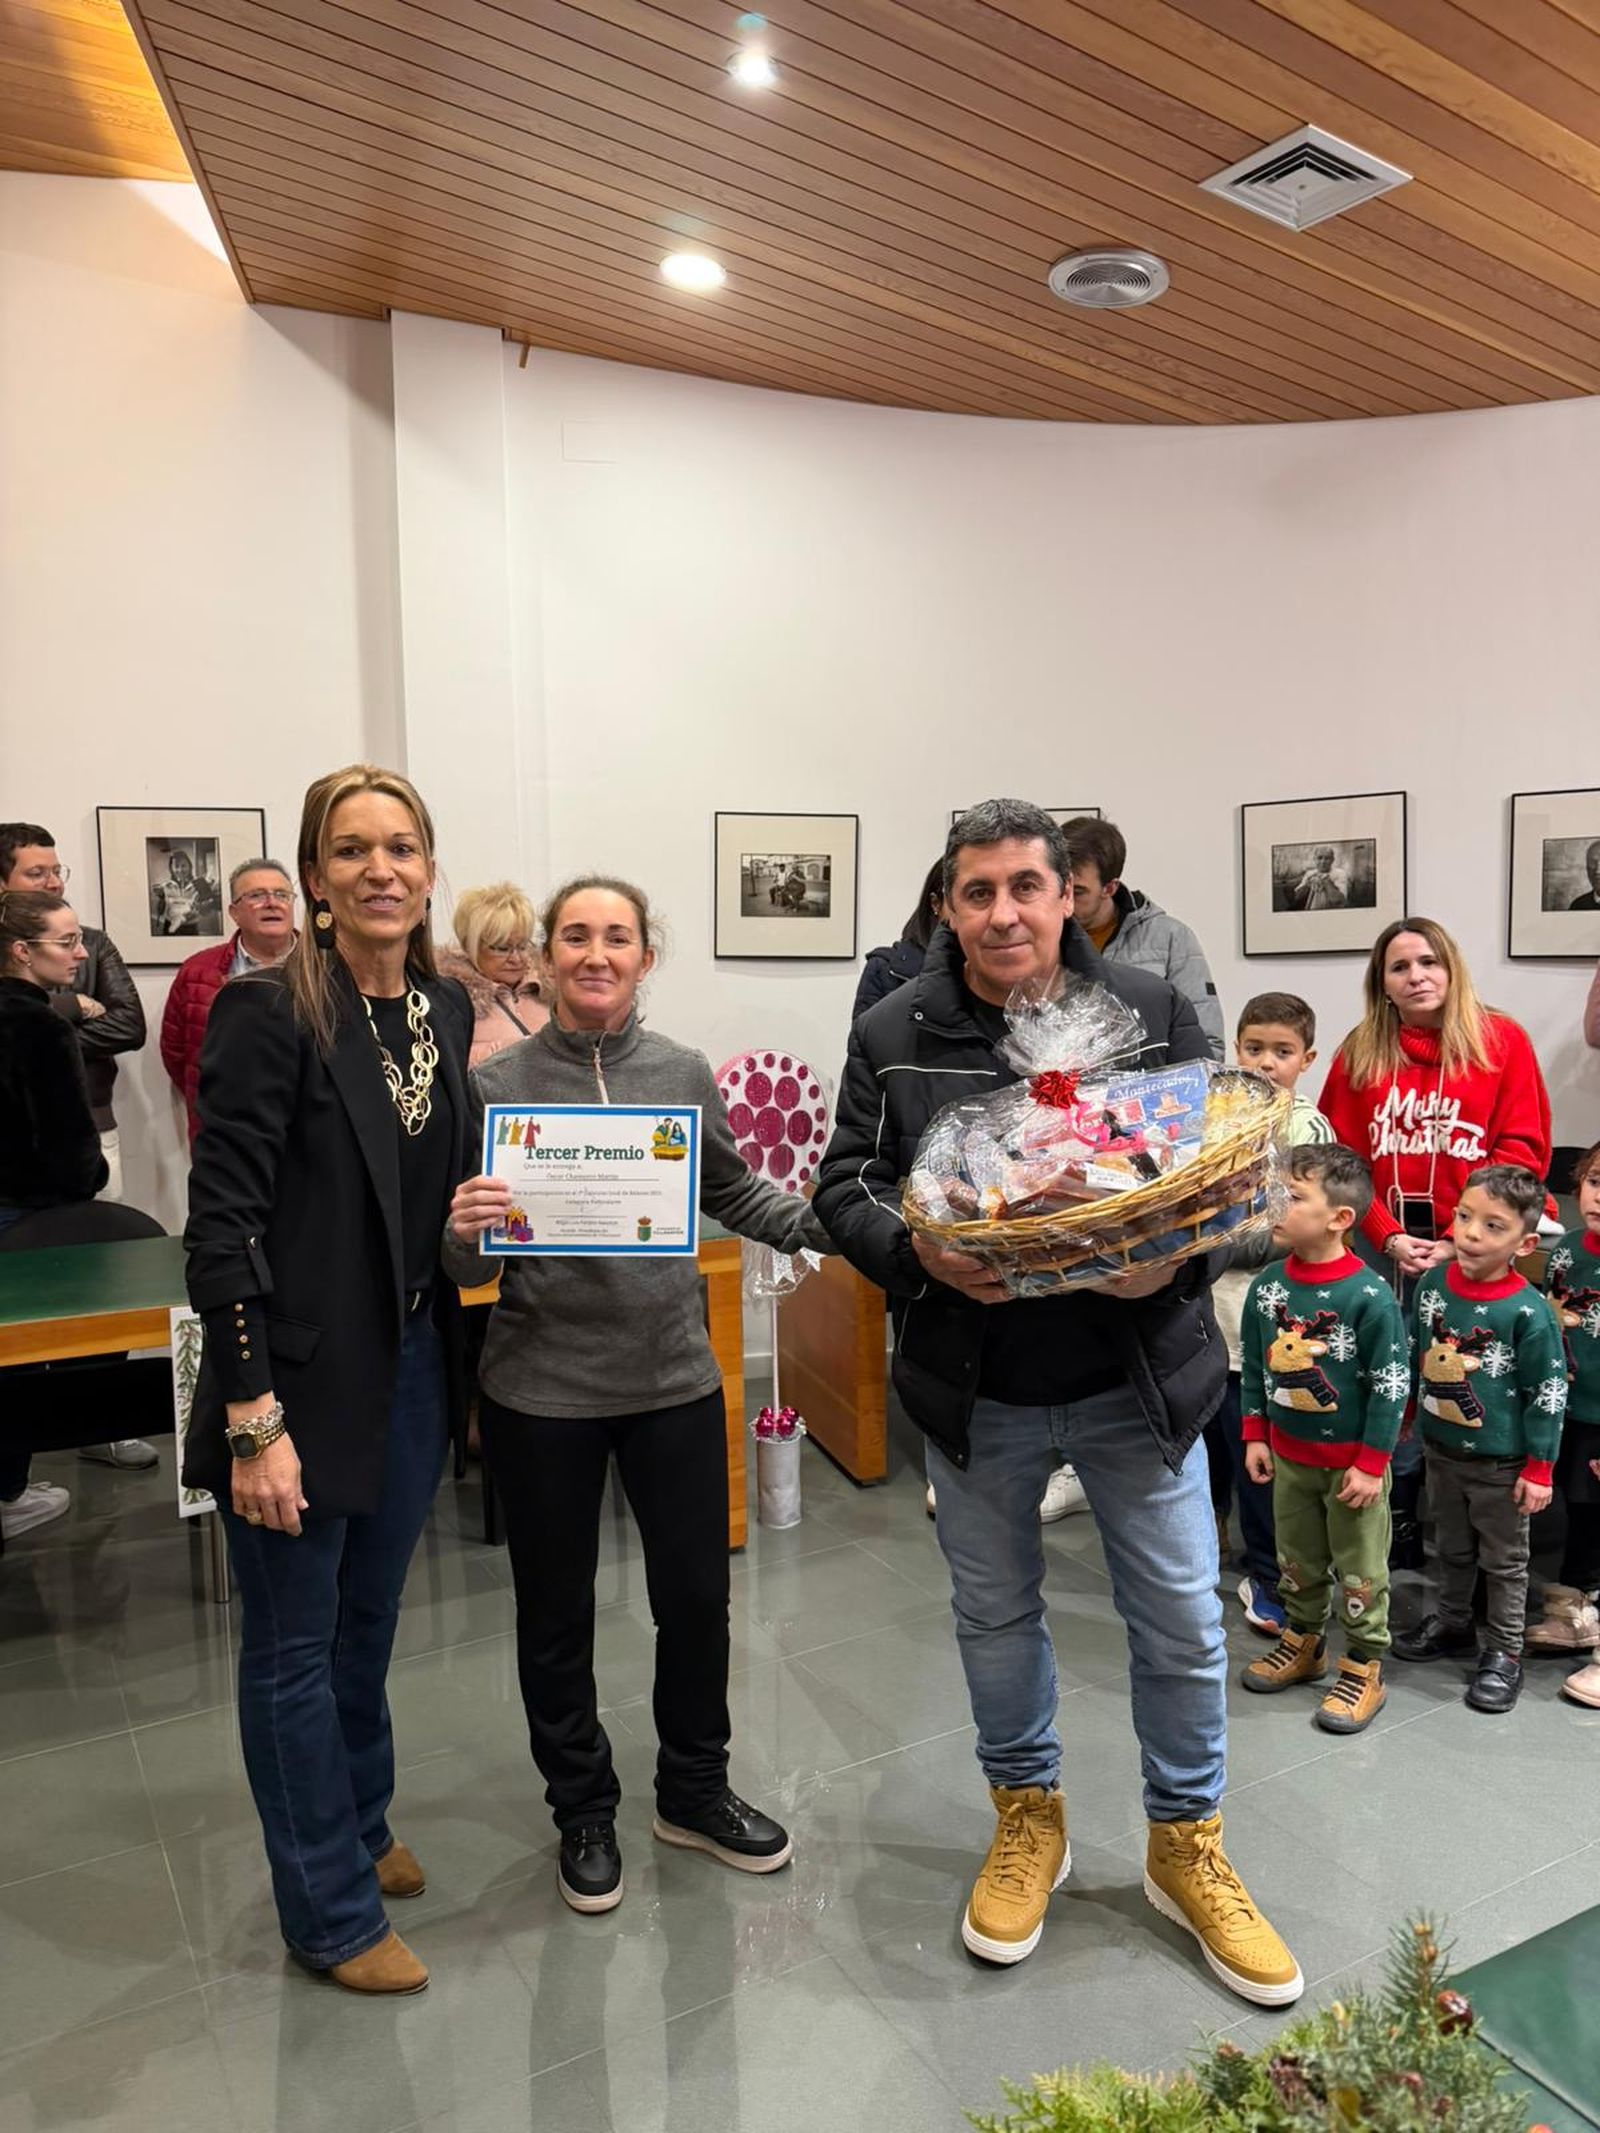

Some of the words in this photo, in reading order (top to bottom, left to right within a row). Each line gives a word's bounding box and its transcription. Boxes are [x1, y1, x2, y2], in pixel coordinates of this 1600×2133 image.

[1374, 1086, 1485, 1137] Merry
[524, 1145, 580, 1161] Tercer
[584, 1145, 644, 1161] Premio
[1368, 1118, 1487, 1161] Christmas
